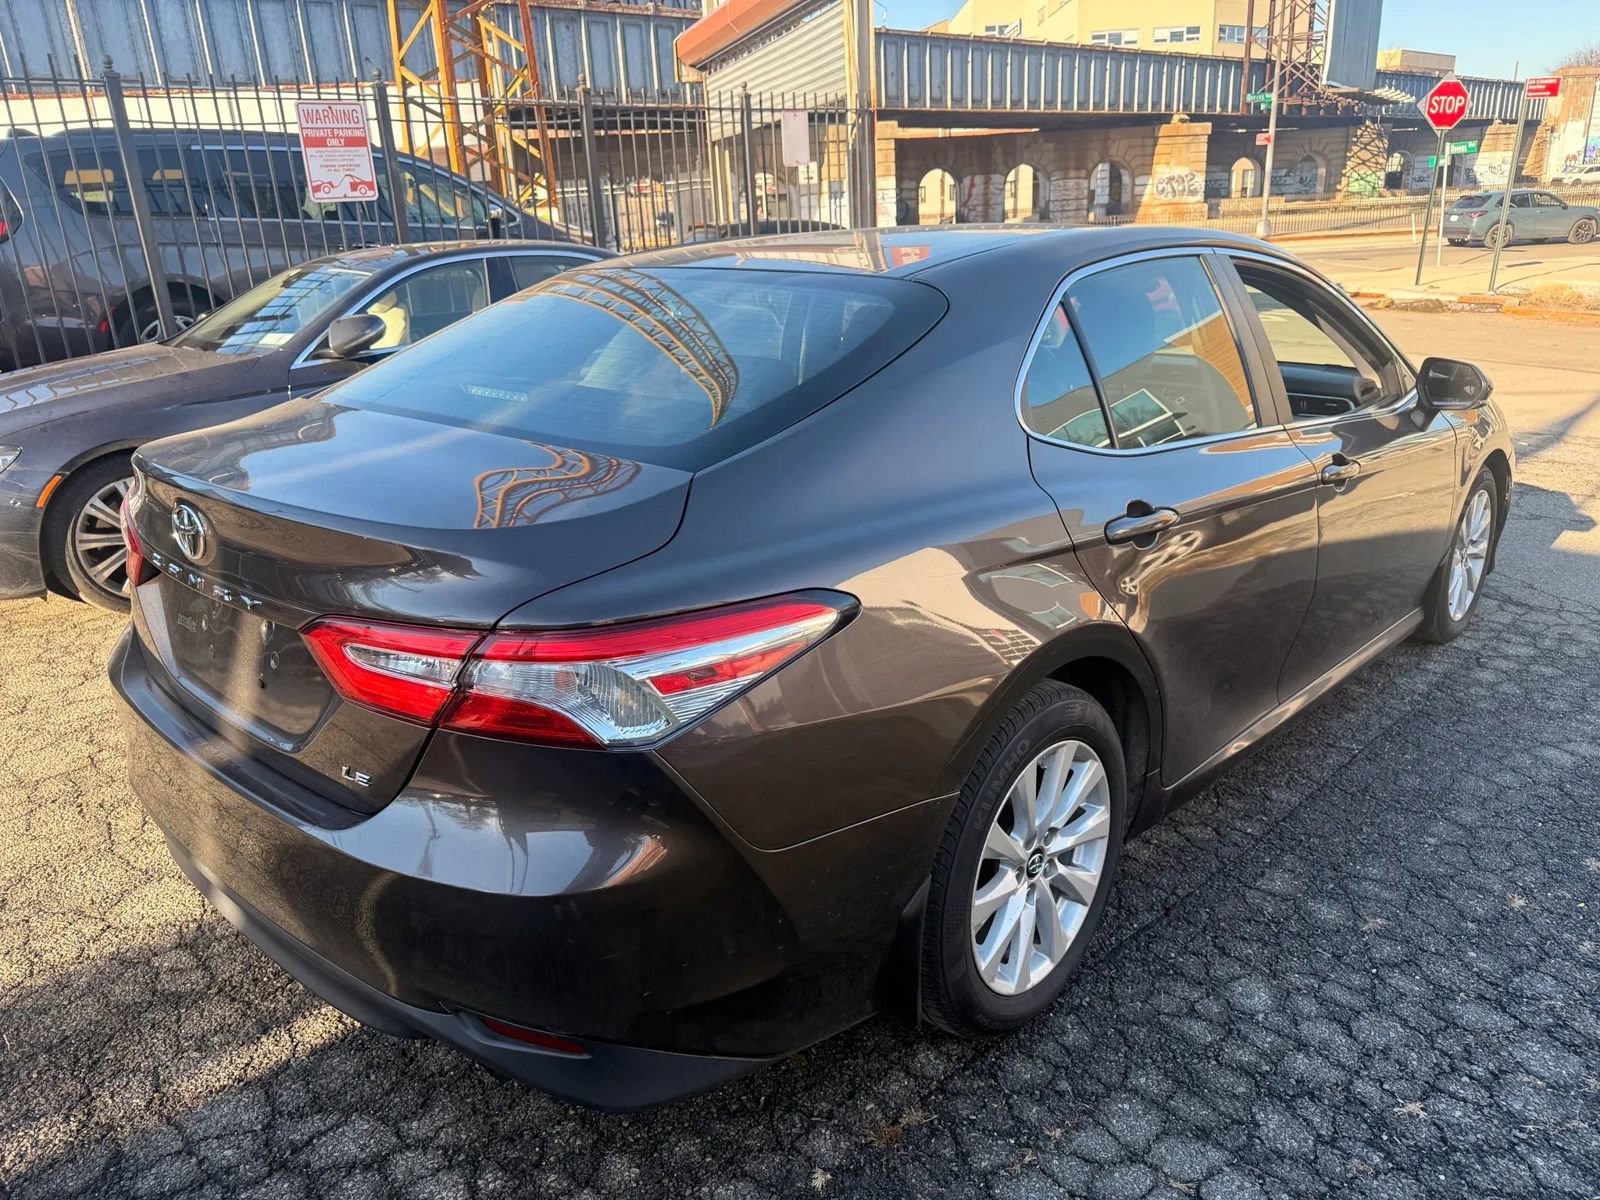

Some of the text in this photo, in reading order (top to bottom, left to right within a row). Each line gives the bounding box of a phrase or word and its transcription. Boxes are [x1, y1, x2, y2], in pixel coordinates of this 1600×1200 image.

[1429, 96, 1465, 114] STOP
[302, 108, 359, 124] WARNING
[303, 128, 365, 137] PRIVATE PARKING
[327, 138, 344, 146] ONLY
[341, 765, 372, 787] LE
[972, 737, 1031, 832] KUMHO
